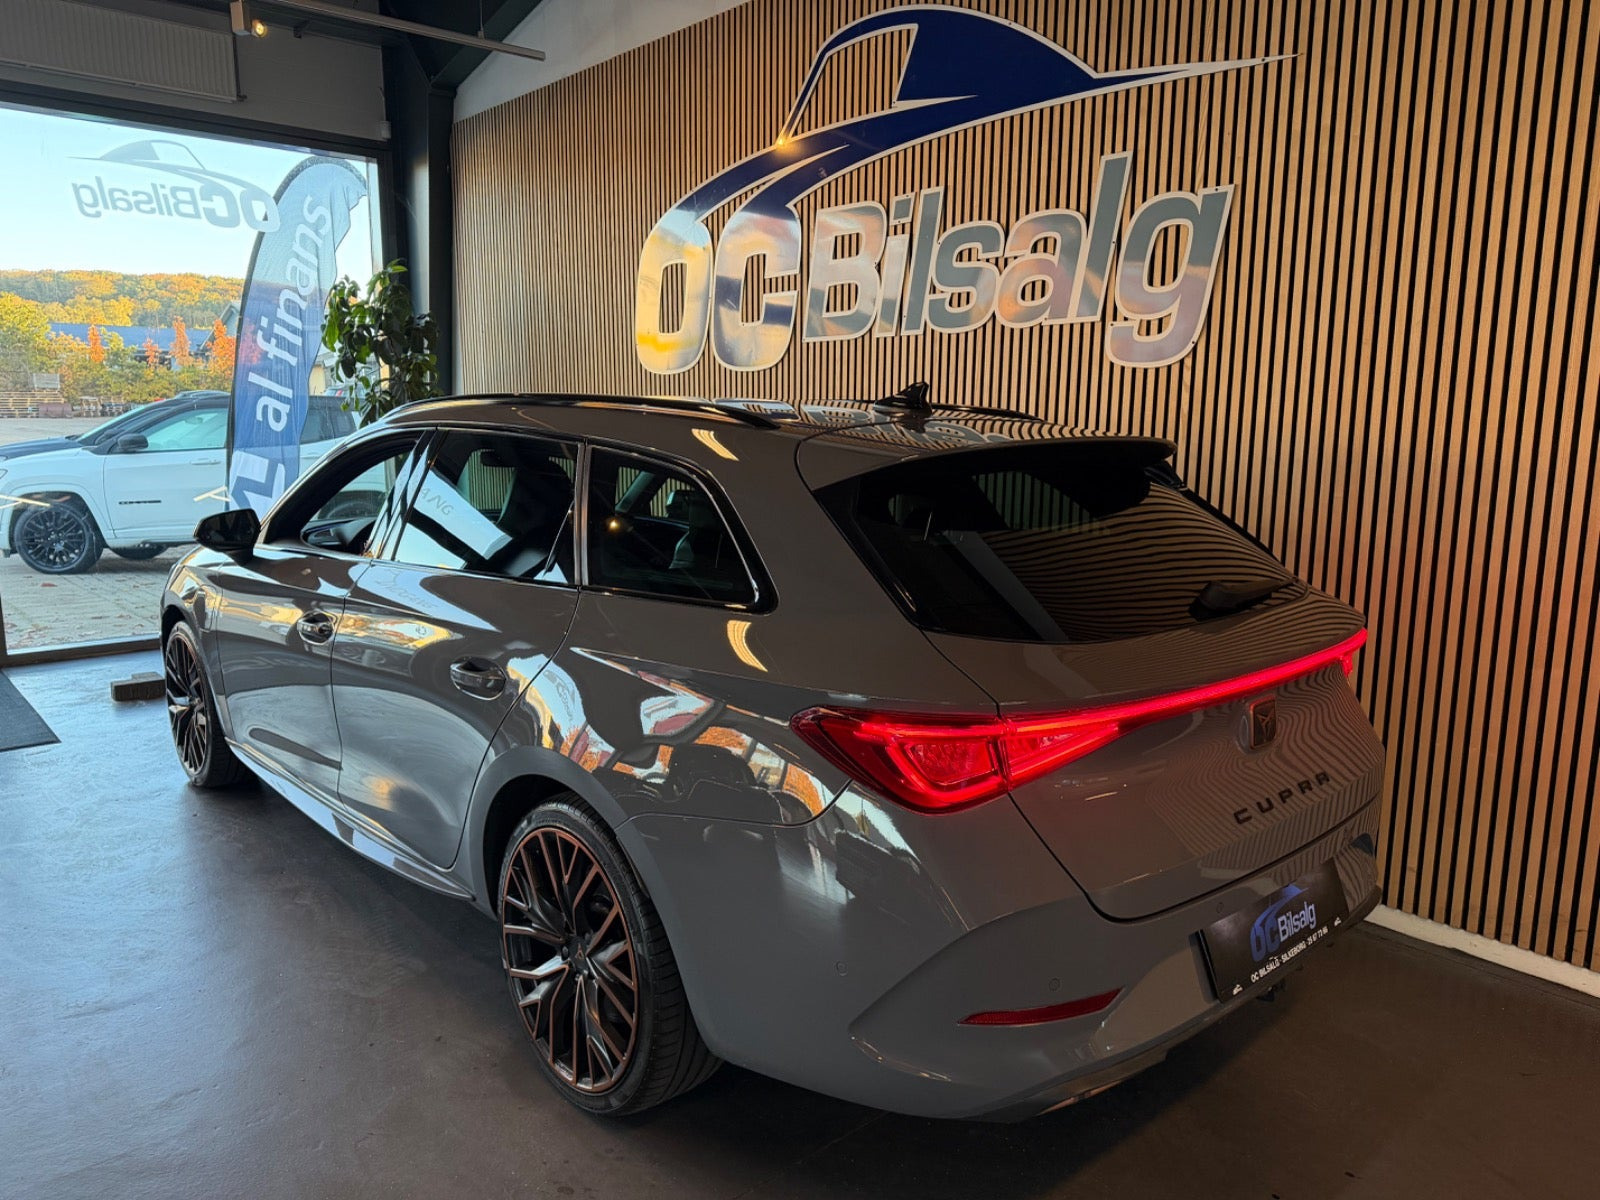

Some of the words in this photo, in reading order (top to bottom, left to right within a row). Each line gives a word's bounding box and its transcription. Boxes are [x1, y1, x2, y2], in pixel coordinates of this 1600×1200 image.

[256, 195, 333, 368] finans
[247, 371, 294, 432] al
[1233, 771, 1330, 825] CUPRA
[1250, 971, 1259, 983] OC
[1281, 940, 1307, 963] SILKEBORG
